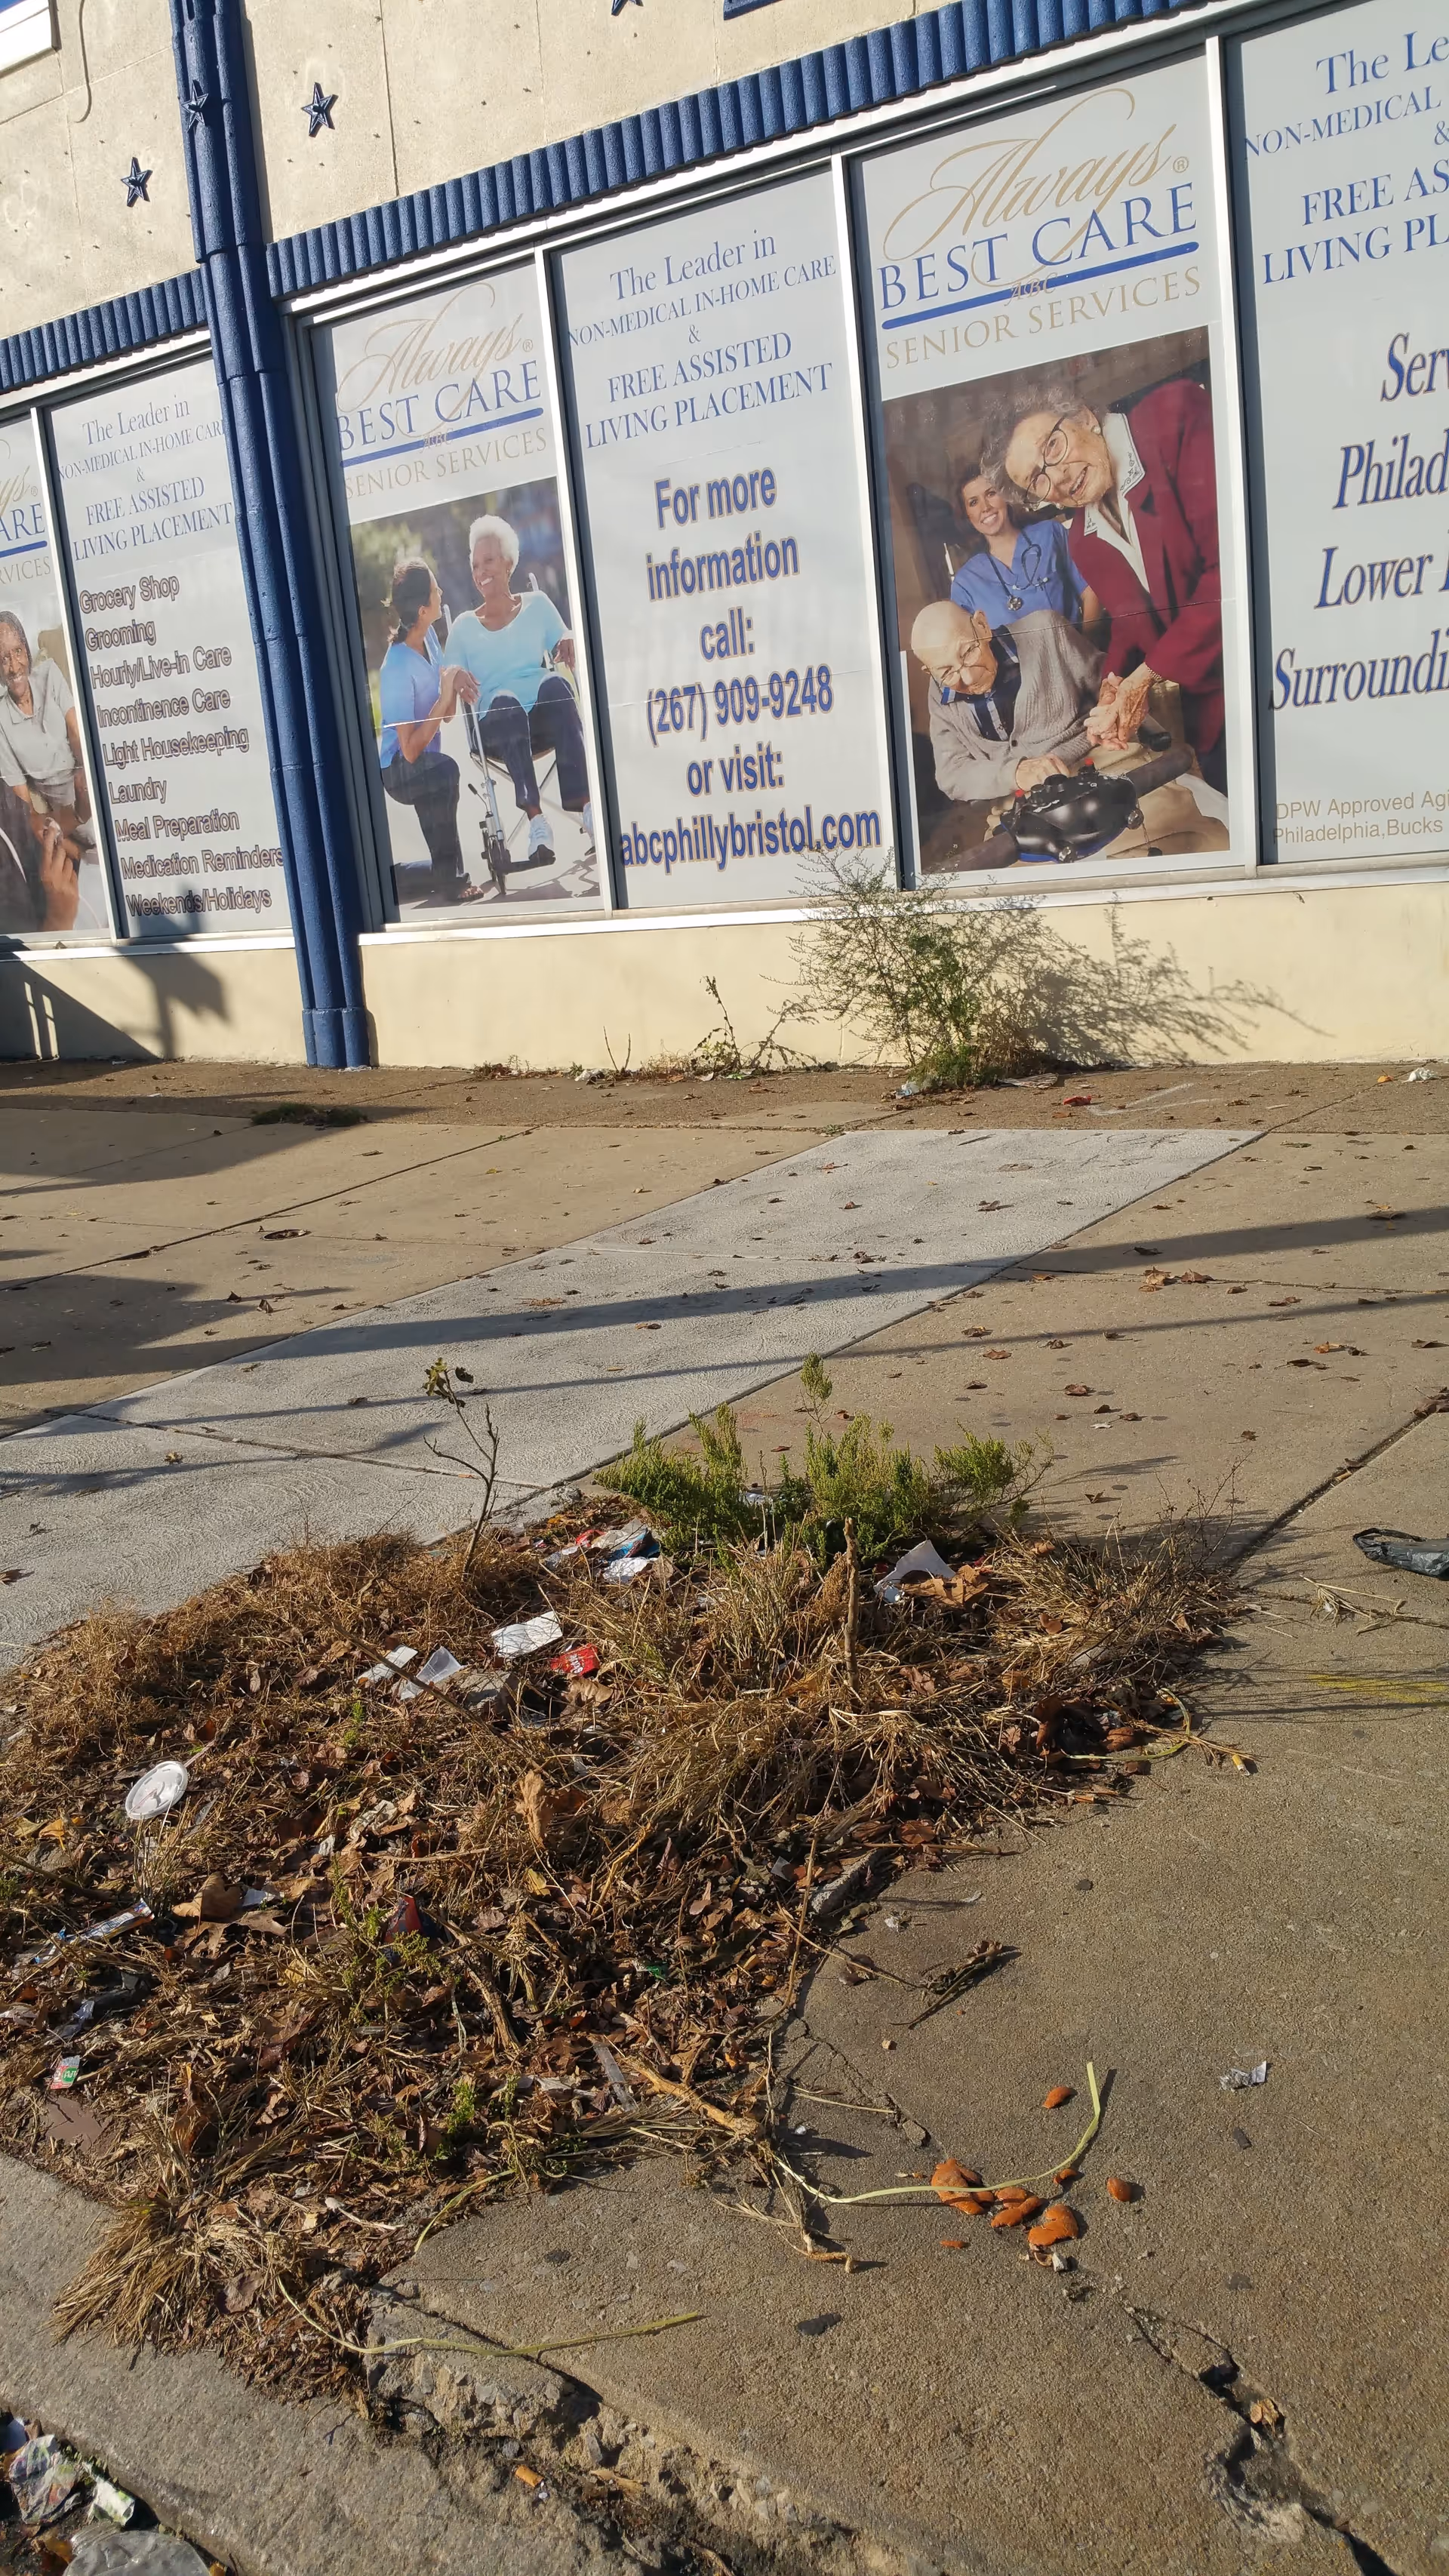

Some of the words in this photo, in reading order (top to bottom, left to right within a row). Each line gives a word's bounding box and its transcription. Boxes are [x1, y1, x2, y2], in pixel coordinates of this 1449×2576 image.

[1316, 49, 1389, 94] The
[1244, 85, 1441, 157] NON-MEDICAL
[883, 88, 1177, 288] Always
[1301, 174, 1394, 226] FREE
[610, 266, 657, 300] The
[664, 241, 746, 287] Leader
[753, 229, 777, 260] in
[876, 233, 1008, 311] BEST
[1032, 182, 1198, 266] CARE
[1262, 226, 1392, 285] LIVING
[568, 297, 691, 347] NON-MEDICAL
[695, 271, 780, 312] IN-HOME
[784, 255, 837, 287] CARE
[886, 314, 1019, 369] SENIOR
[1029, 266, 1201, 334] SERVICES
[1004, 272, 1059, 307] ABC
[337, 282, 526, 437] Always
[688, 325, 701, 344] &
[607, 364, 667, 403] FREE
[672, 331, 792, 387] ASSISTED
[82, 420, 112, 445] The
[118, 402, 170, 435] Leader
[174, 394, 190, 418] in
[337, 394, 419, 451] BEST
[435, 359, 541, 423] CARE
[586, 404, 668, 449] LIVING
[675, 362, 833, 426] PLACEMENT
[57, 445, 137, 480] NON-MEDICAL
[139, 429, 194, 459] IN-HOME
[344, 460, 431, 500] SENIOR
[436, 427, 547, 478] SERVICES
[420, 428, 454, 453] ABC
[85, 497, 125, 525] FREE
[129, 476, 205, 512] ASSISTED
[137, 466, 145, 482] &
[654, 477, 700, 529] For
[706, 466, 777, 520] more
[74, 530, 128, 562] LIVING
[132, 503, 232, 552] PLACEMENT
[80, 585, 137, 614] Grocery
[139, 574, 180, 604] Shop
[645, 531, 800, 602] information
[1313, 546, 1433, 610] Lower
[85, 620, 156, 651] Grooming
[700, 606, 755, 662] call:
[90, 651, 189, 689] Hourly/Live-in
[193, 646, 232, 671] Care
[97, 697, 189, 728] Incontinence
[192, 689, 231, 714] Care
[645, 682, 709, 748] (267)
[714, 663, 835, 727] 909-9248
[103, 743, 139, 770] Light
[140, 726, 250, 761] Housekeeping
[687, 756, 713, 797] or
[718, 740, 786, 793] visit:
[109, 777, 167, 805] Laundry
[1276, 800, 1321, 820] DPW
[1327, 792, 1414, 819] Approved
[115, 819, 150, 842] Meal
[152, 809, 240, 841] Preparation
[620, 804, 882, 876] abcphillybristol.com
[121, 851, 200, 880] Medication
[202, 845, 284, 869] Reminders
[126, 885, 272, 917] Weekends/Holidays
